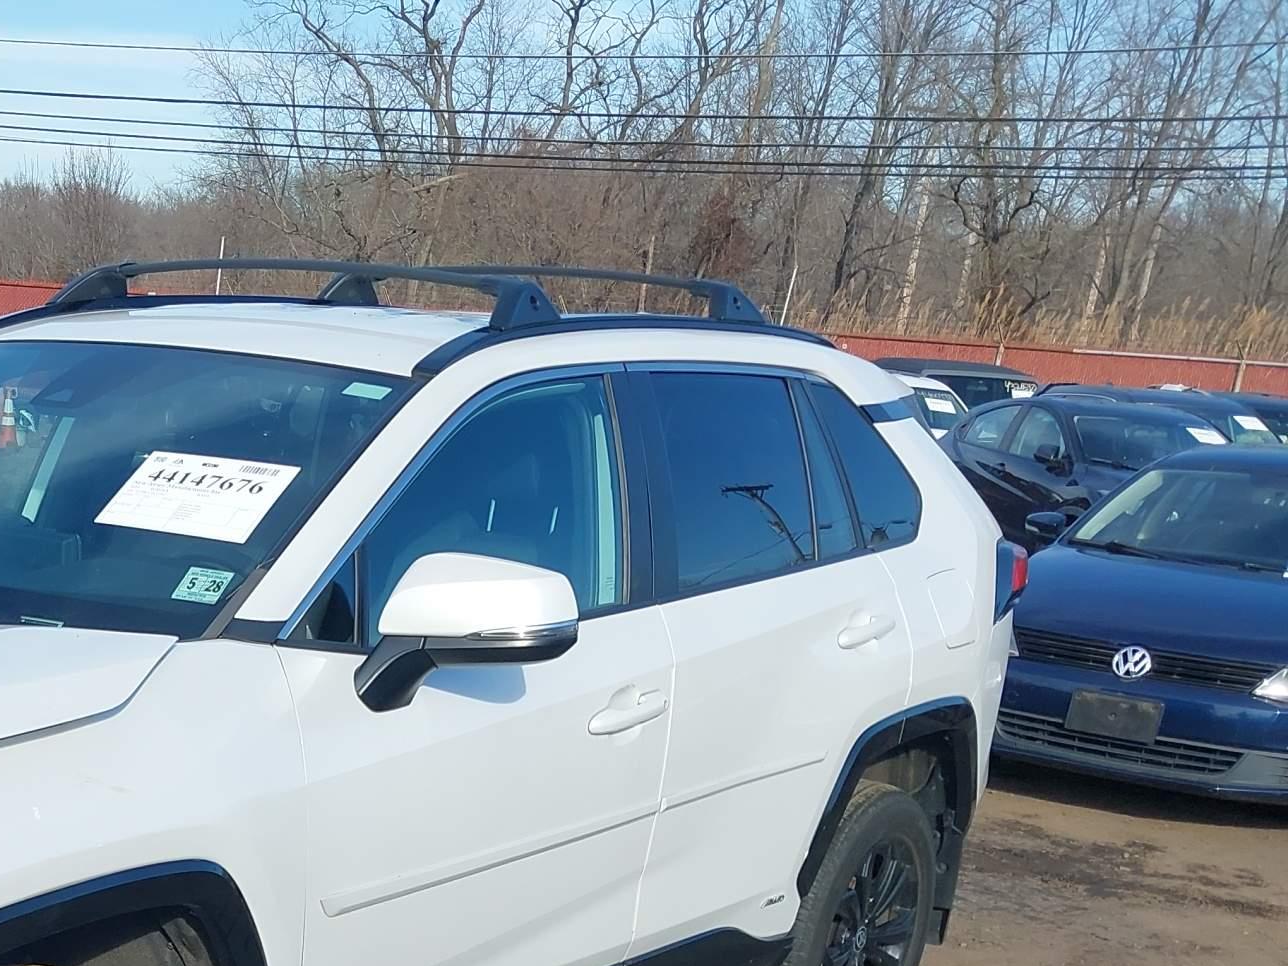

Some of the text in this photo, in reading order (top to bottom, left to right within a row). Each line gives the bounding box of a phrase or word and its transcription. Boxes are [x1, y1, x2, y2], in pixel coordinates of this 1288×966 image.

[148, 468, 269, 495] 44147676
[186, 577, 224, 594] 5 28
